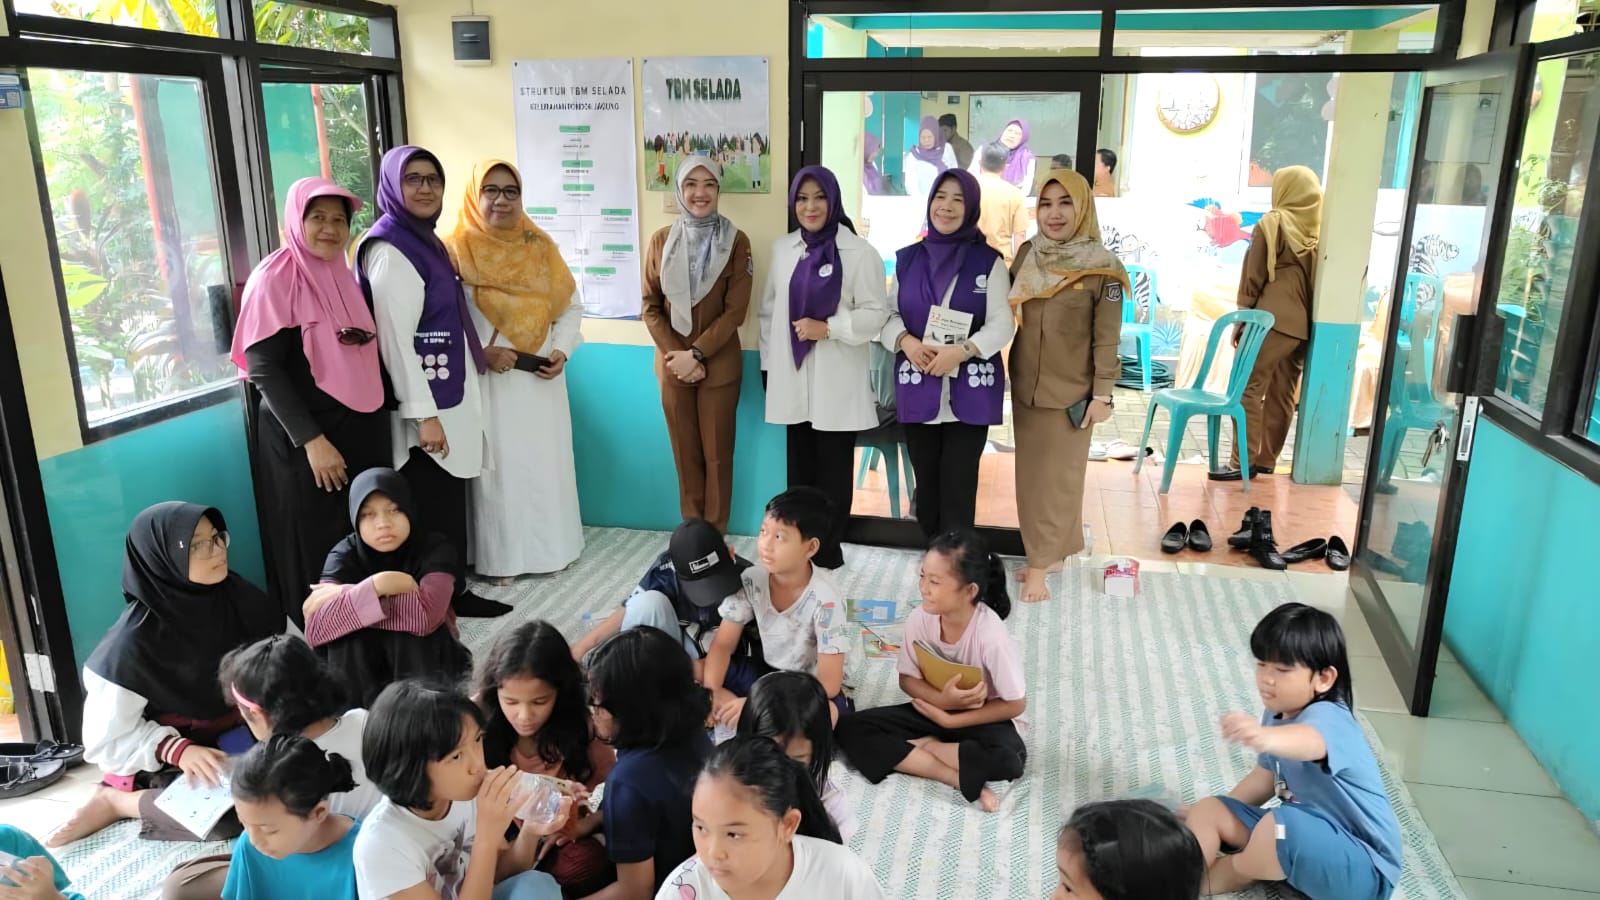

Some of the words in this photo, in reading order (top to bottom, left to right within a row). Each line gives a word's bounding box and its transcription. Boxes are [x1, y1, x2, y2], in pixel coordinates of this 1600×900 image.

[519, 86, 566, 96] STRUKTUR
[570, 86, 588, 96] TBM
[591, 85, 627, 96] SELADA
[665, 77, 691, 100] TBM
[693, 77, 741, 100] SELADA
[529, 102, 567, 111] KELURAHAN
[594, 102, 620, 111] JAGUNG
